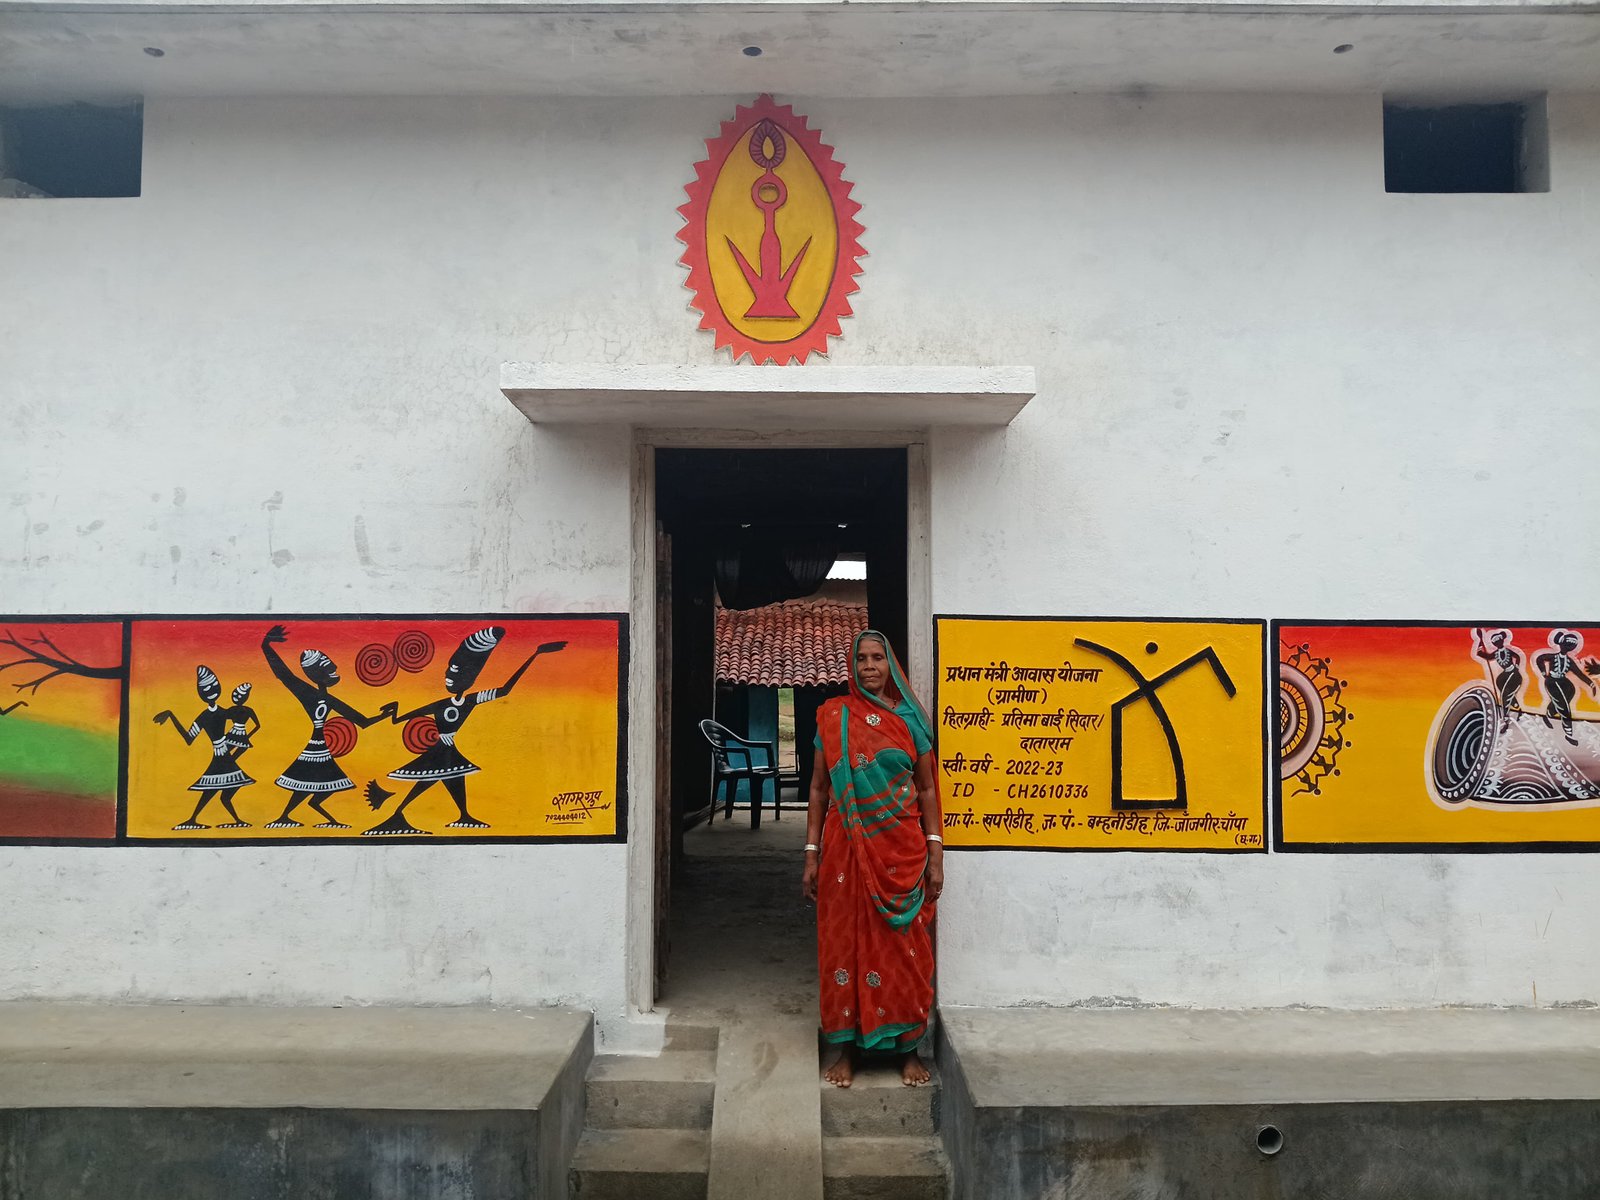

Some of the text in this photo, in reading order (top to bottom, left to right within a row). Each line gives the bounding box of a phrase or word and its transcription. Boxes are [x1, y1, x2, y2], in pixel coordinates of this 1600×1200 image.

[945, 661, 1103, 684] प्रधान मंत्री आवास योजना
[1000, 707, 1041, 730] प्रतिमा
[1041, 708, 1064, 733] बाई
[1019, 737, 1074, 754] दाताराम
[1006, 759, 1064, 776] 2022-23
[951, 782, 975, 798] ID
[1007, 783, 1089, 799] CH2610336
